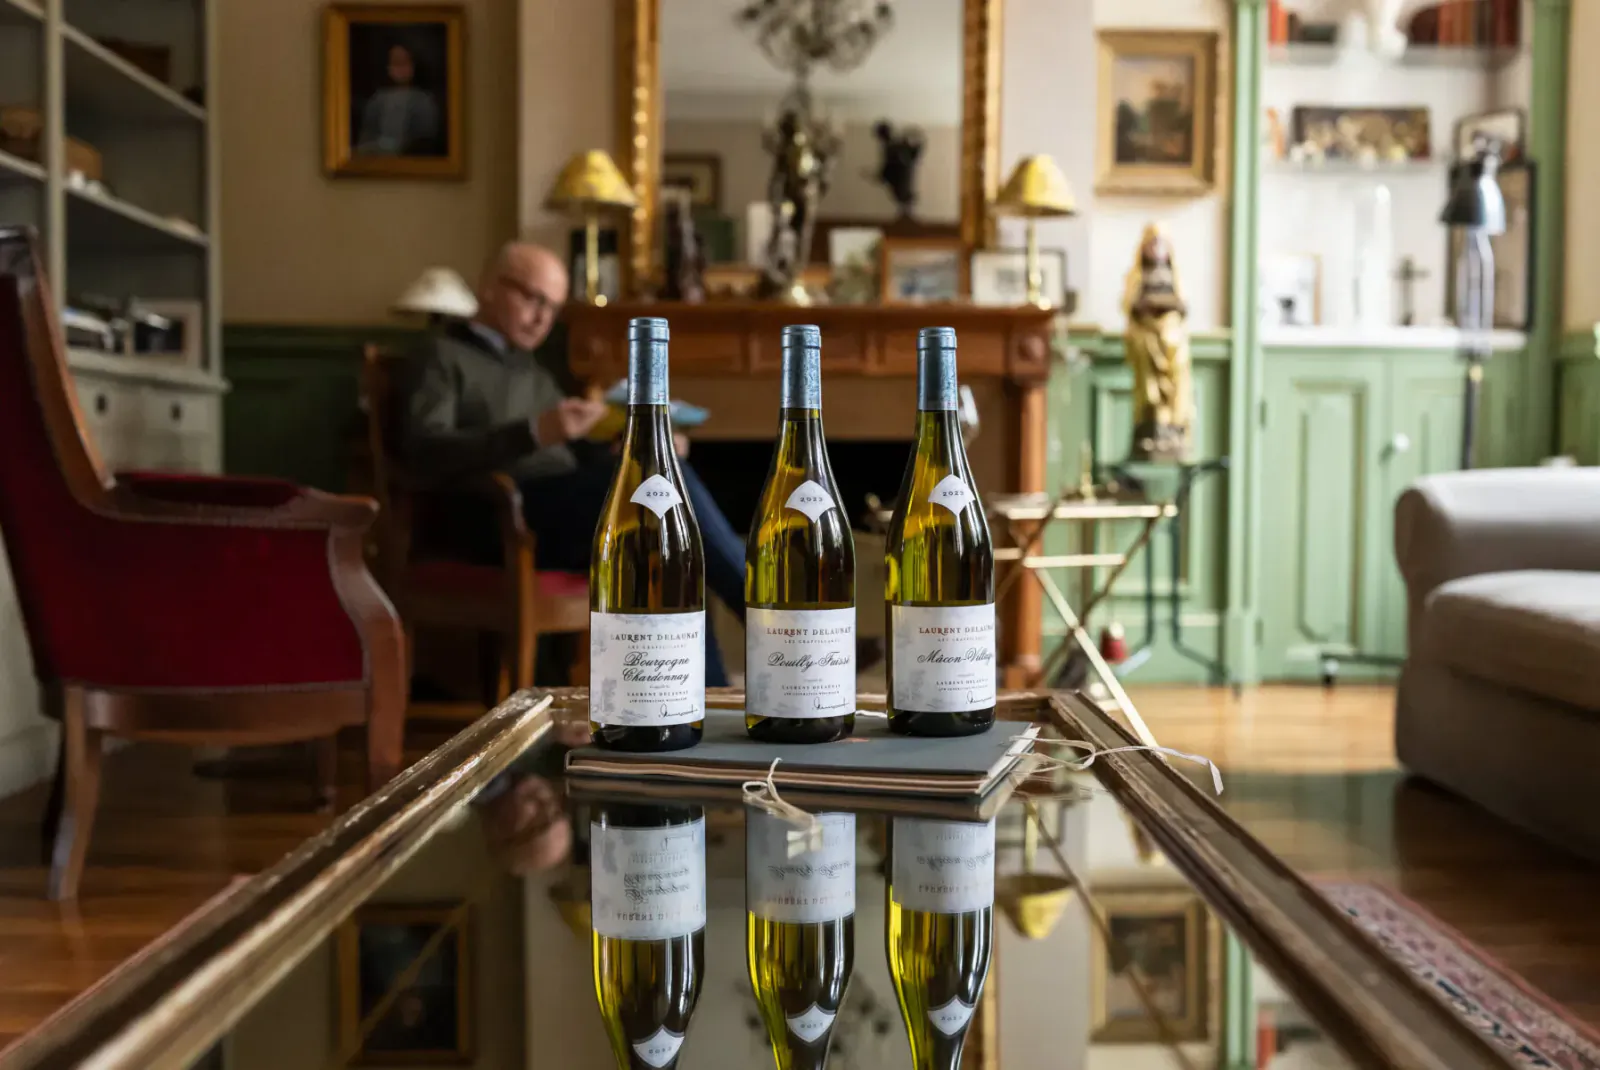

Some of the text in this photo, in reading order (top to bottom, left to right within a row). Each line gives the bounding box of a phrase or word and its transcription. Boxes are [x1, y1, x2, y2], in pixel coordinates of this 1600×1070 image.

[610, 631, 698, 643] LAURENT DELAUNAY
[766, 626, 852, 637] LAURENT DELAUNAY
[919, 627, 962, 636] LAURENT
[623, 651, 690, 671] Bourgogne
[622, 668, 690, 685] Chardonnay
